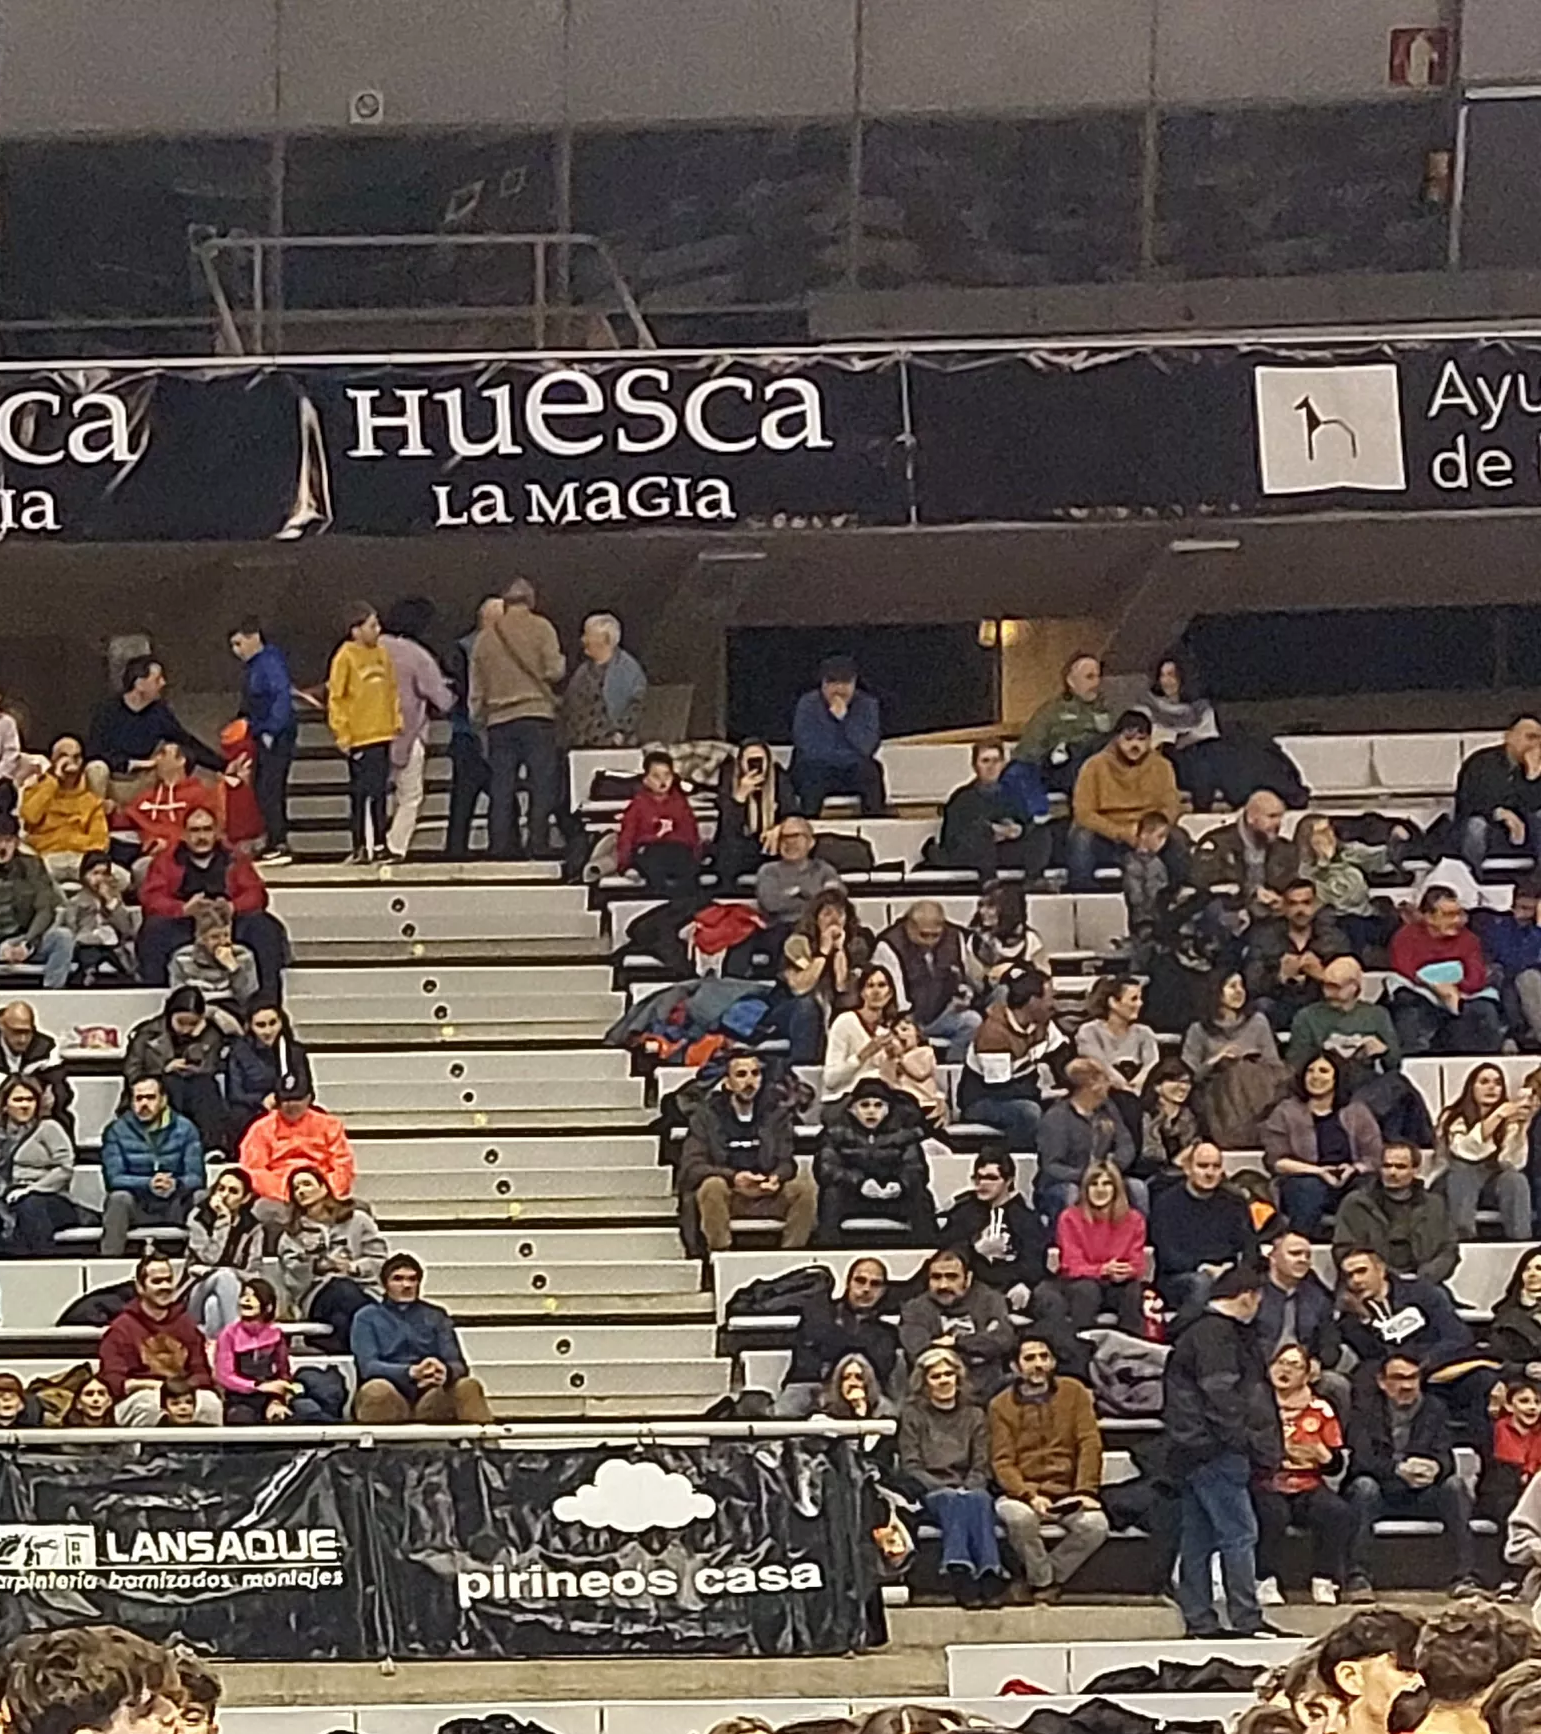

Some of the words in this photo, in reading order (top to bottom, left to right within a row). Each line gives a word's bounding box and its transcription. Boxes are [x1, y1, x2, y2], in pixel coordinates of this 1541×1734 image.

[345, 367, 833, 459] Huesca
[1432, 433, 1515, 489] de
[433, 480, 509, 526] La
[107, 1528, 341, 1564] LANSAQUE
[457, 1568, 680, 1606] pirineos
[694, 1561, 824, 1596] casa
